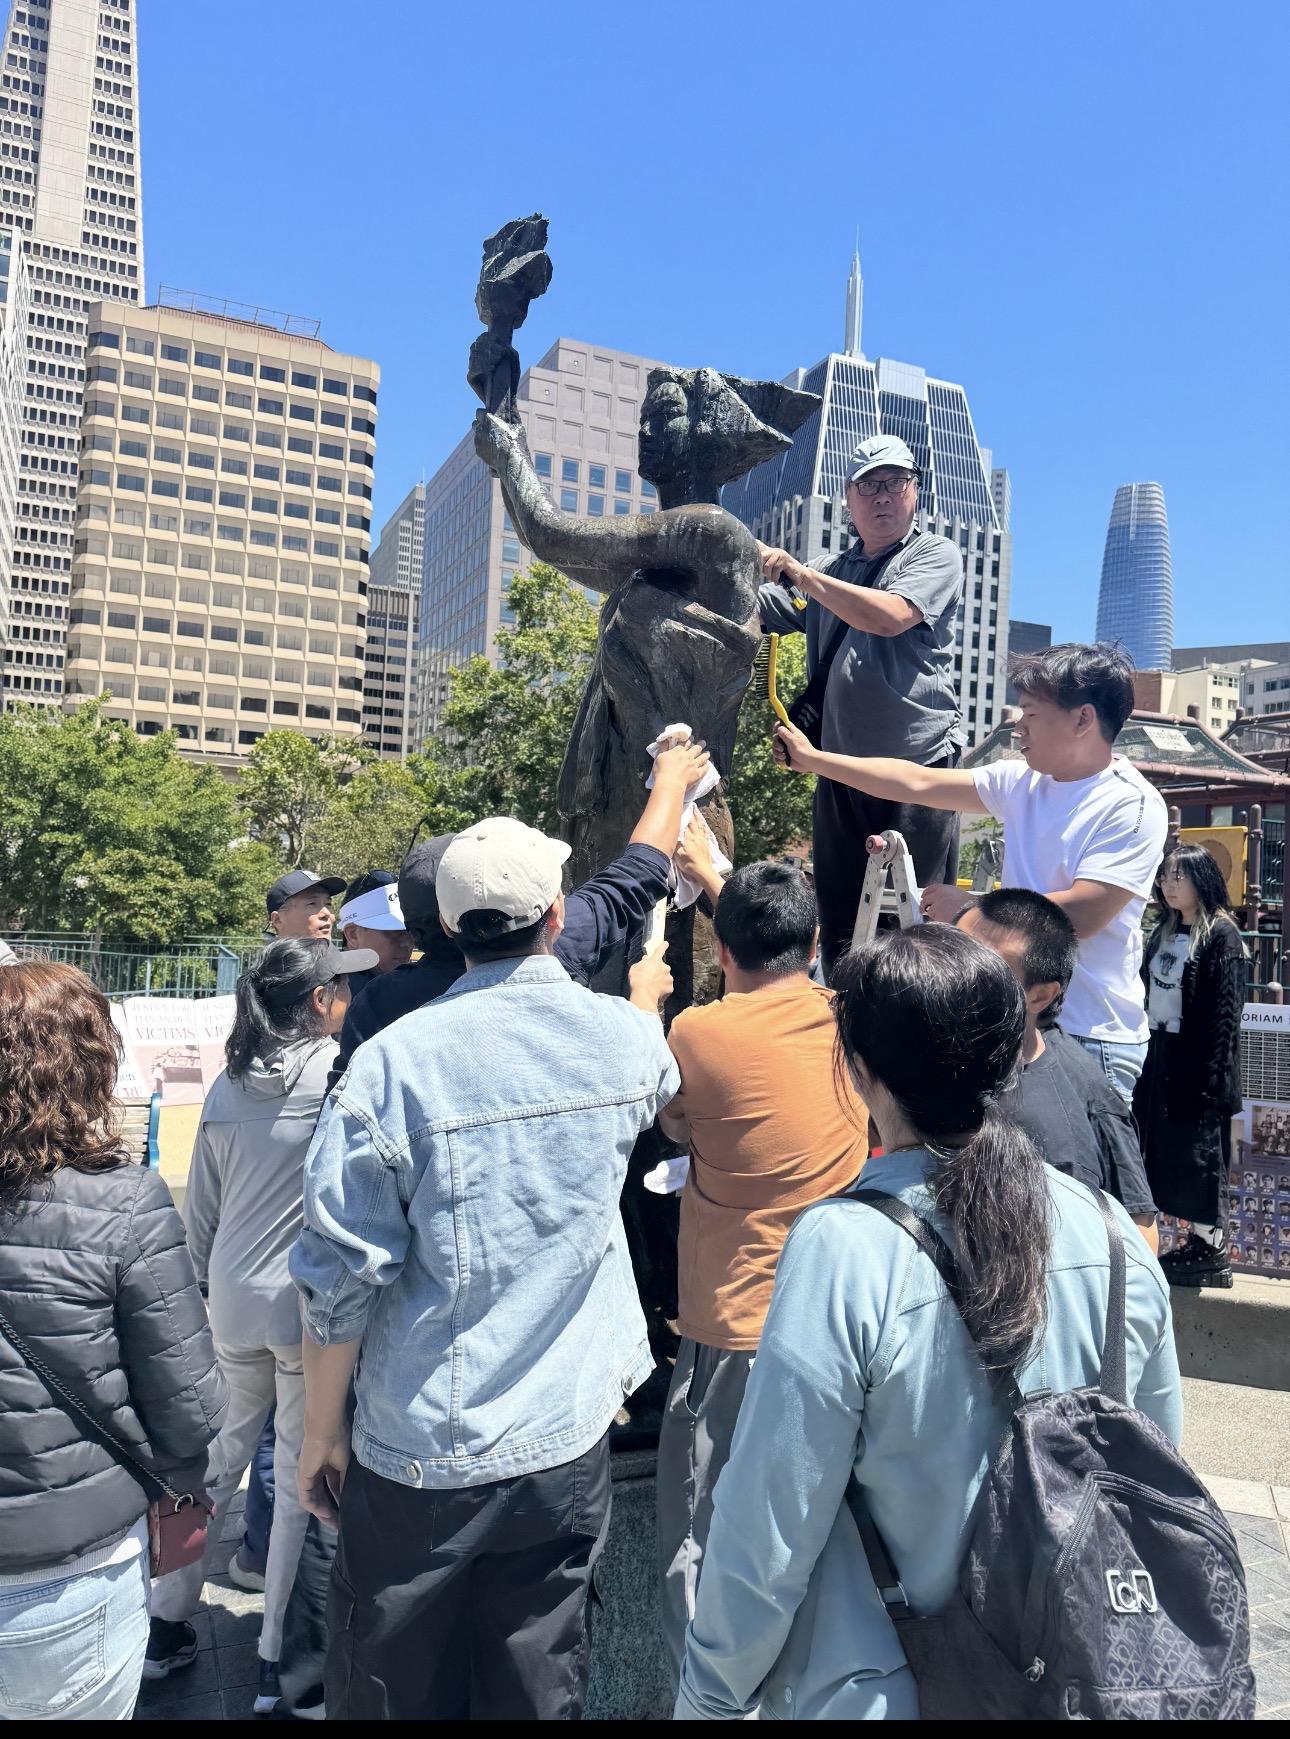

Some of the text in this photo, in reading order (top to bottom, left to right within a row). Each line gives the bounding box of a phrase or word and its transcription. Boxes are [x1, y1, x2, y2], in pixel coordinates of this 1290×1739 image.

[1241, 1013, 1283, 1024] ORIAM
[135, 1026, 197, 1040] VICTIMS
[204, 1025, 229, 1038] VIC
